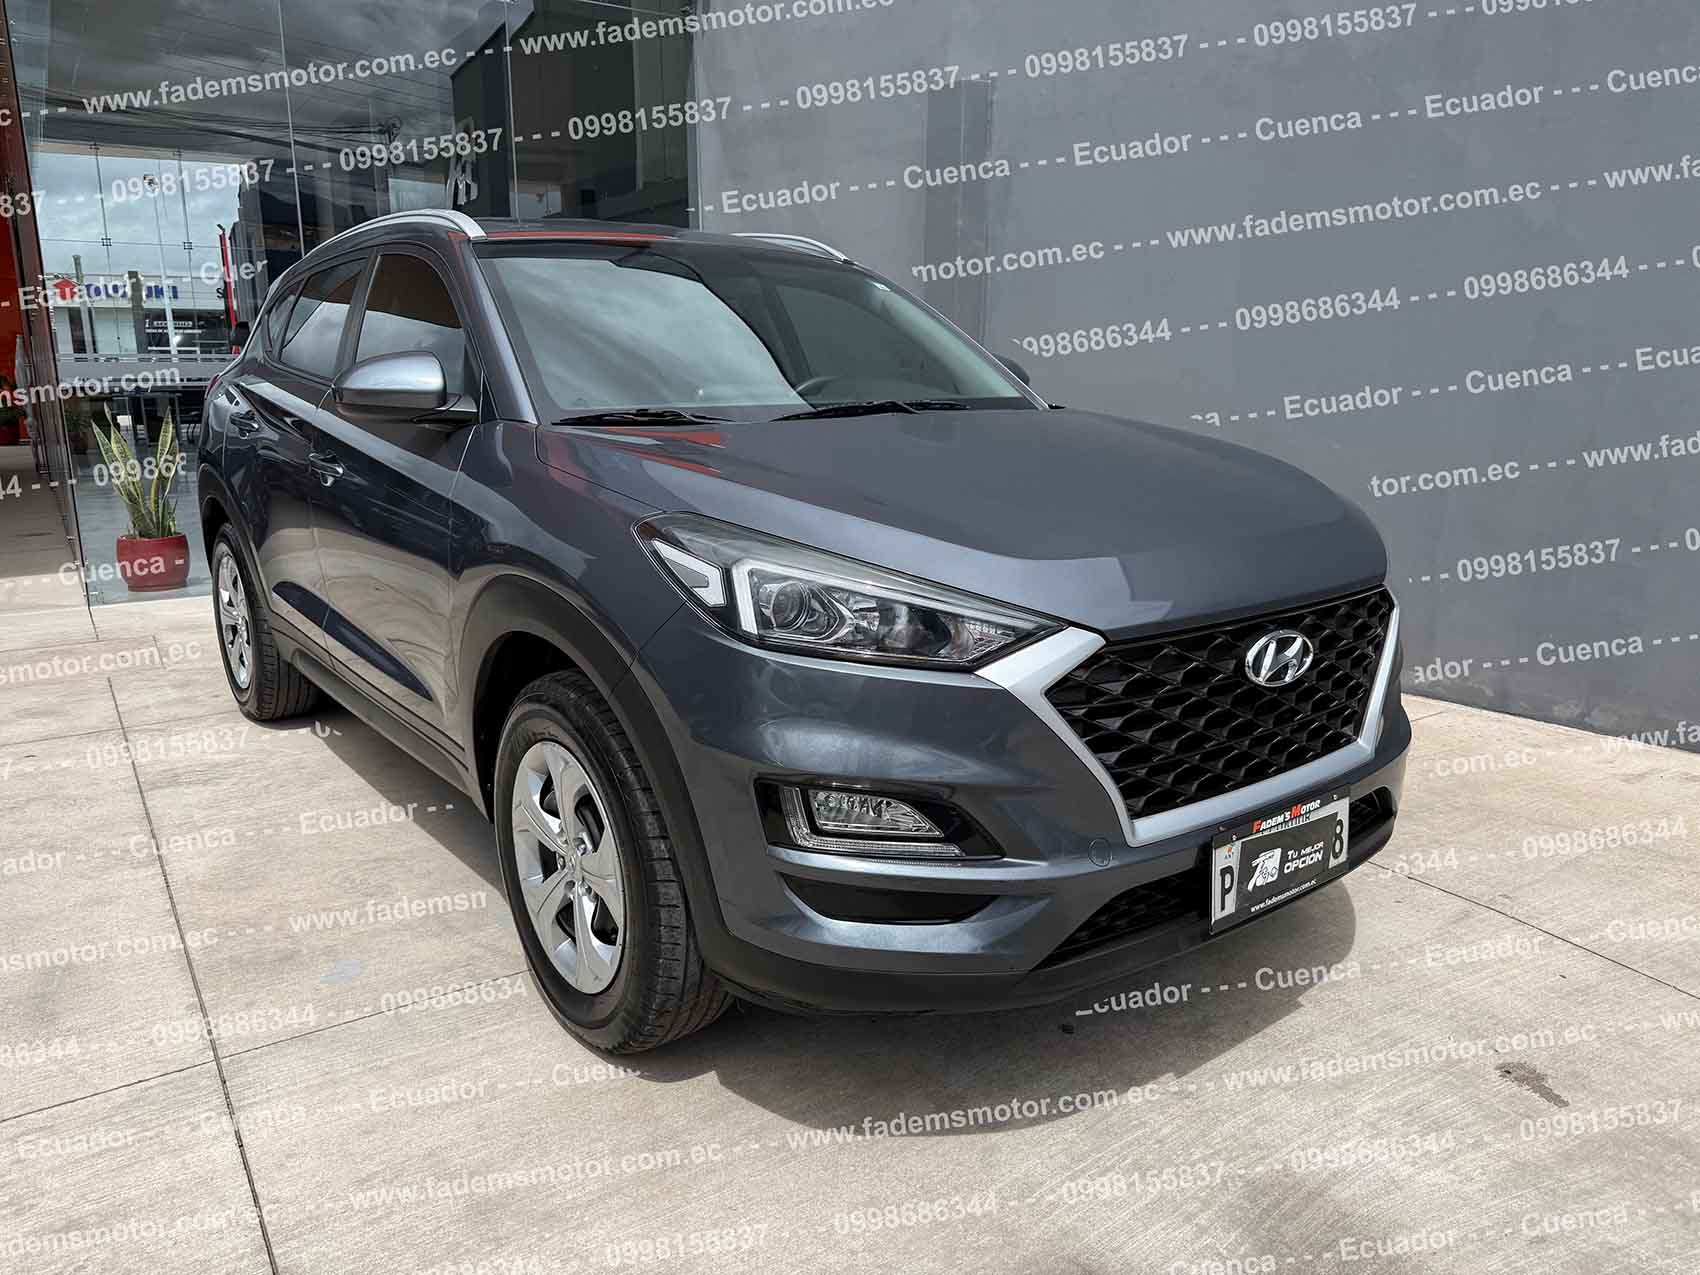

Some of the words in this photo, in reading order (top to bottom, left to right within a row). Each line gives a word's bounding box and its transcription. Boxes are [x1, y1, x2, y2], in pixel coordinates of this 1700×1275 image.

[1290, 799, 1321, 818] MOTOR
[1220, 864, 1235, 913] P
[1331, 818, 1344, 860] 8
